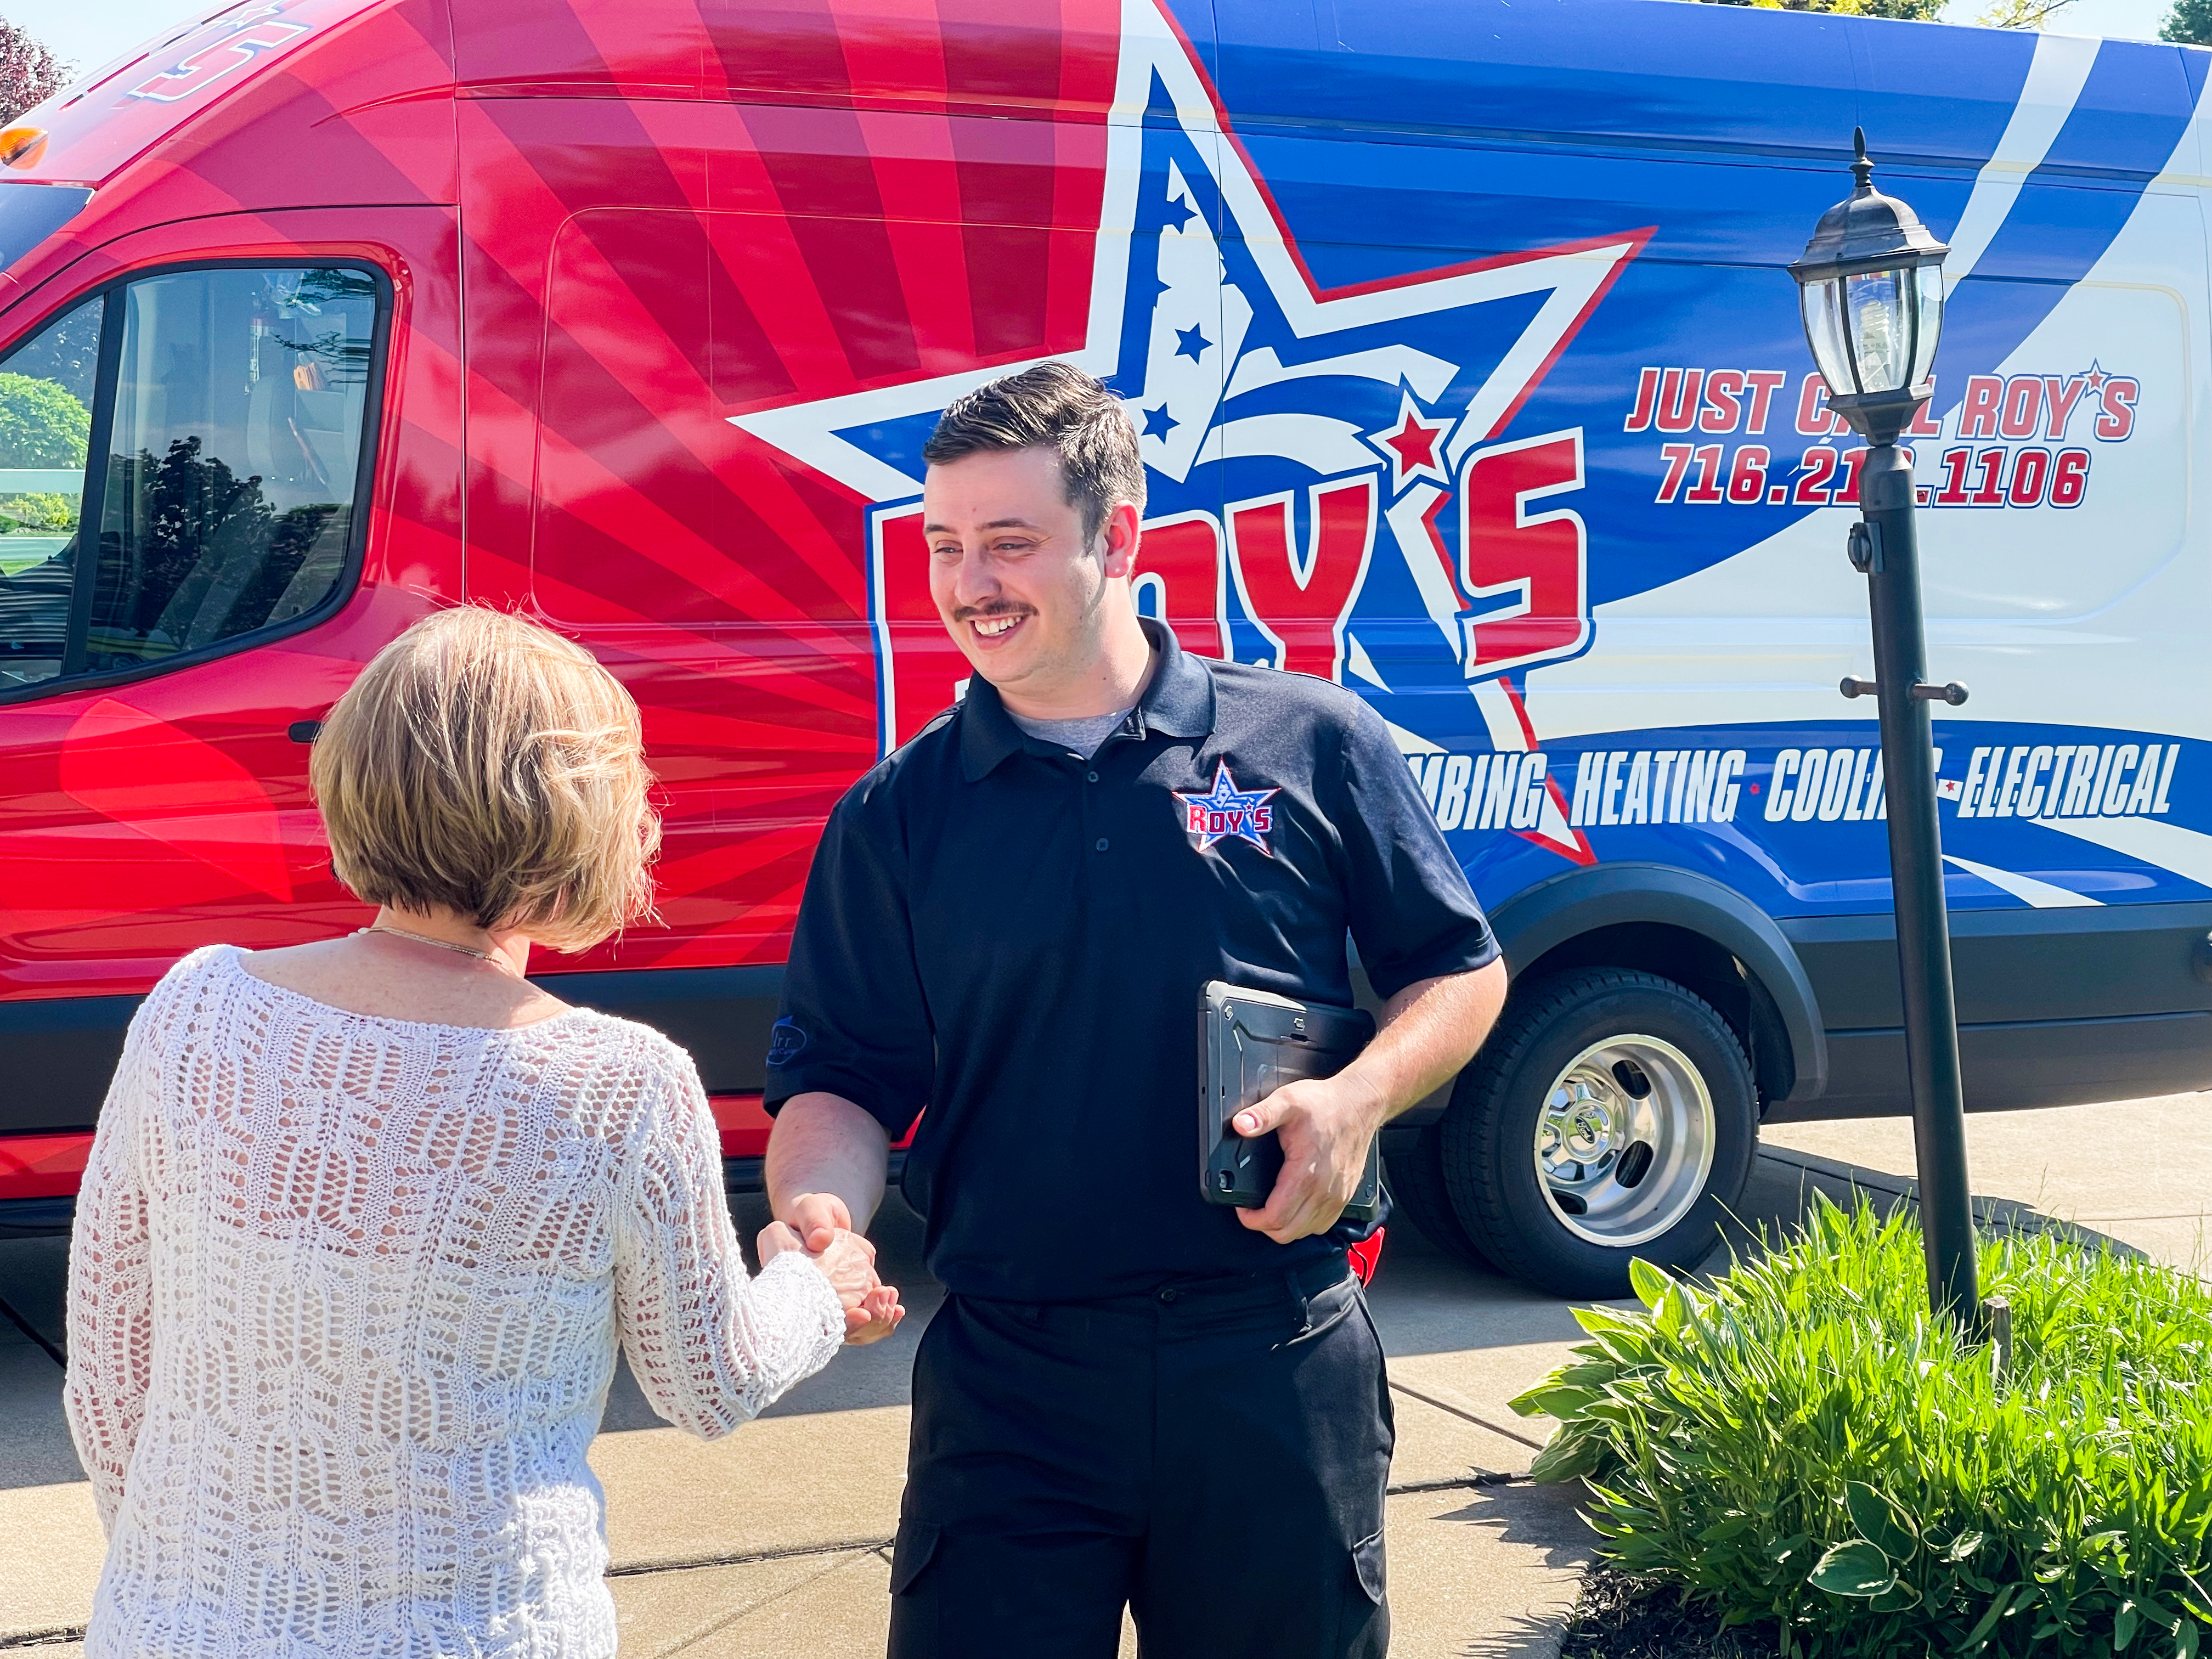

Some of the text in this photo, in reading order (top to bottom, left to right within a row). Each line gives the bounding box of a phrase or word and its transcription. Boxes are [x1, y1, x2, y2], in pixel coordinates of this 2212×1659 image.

[1623, 358, 2141, 443] JUST CL ROY'S
[1654, 443, 2092, 509] 716.21.1106
[871, 391, 1588, 751] Y'S
[1186, 802, 1274, 836] ROY'S
[1407, 743, 2181, 831] MBING HEATING COOLI ELECTRICAL
